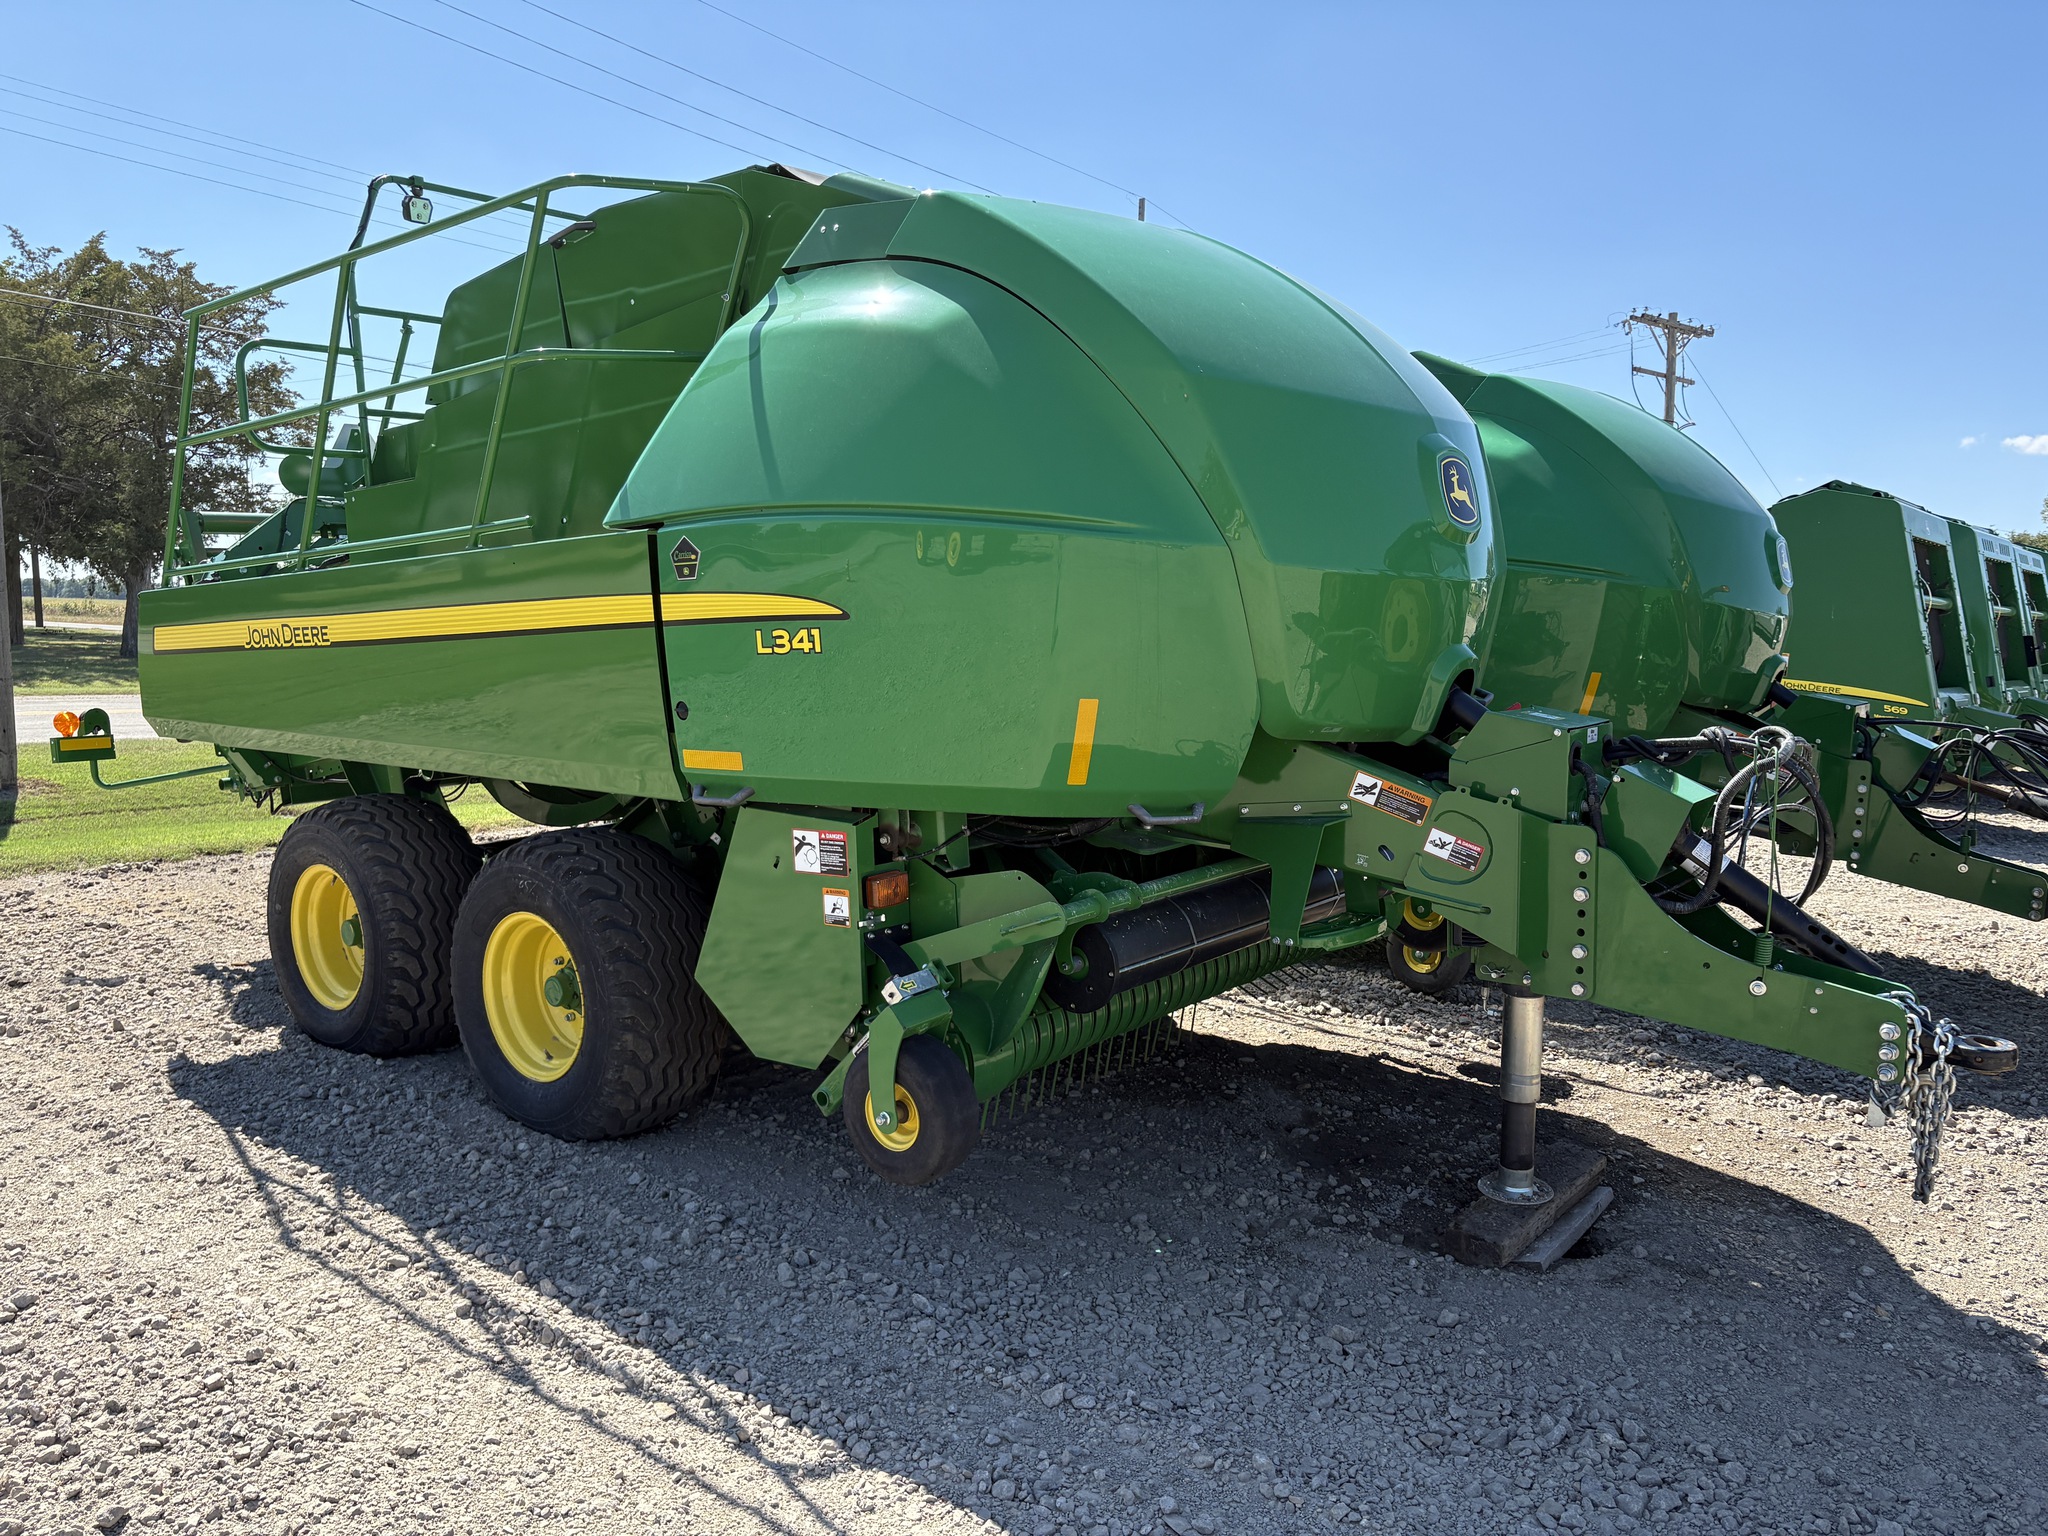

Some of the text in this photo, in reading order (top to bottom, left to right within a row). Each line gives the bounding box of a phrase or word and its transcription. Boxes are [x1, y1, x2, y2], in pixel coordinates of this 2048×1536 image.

[245, 623, 331, 647] JOHN DEERE
[755, 627, 822, 655] L341
[1808, 683, 1841, 693] DEERE
[1883, 704, 1908, 715] 569
[1394, 786, 1426, 804] WARNING
[1461, 840, 1482, 852] DANGER
